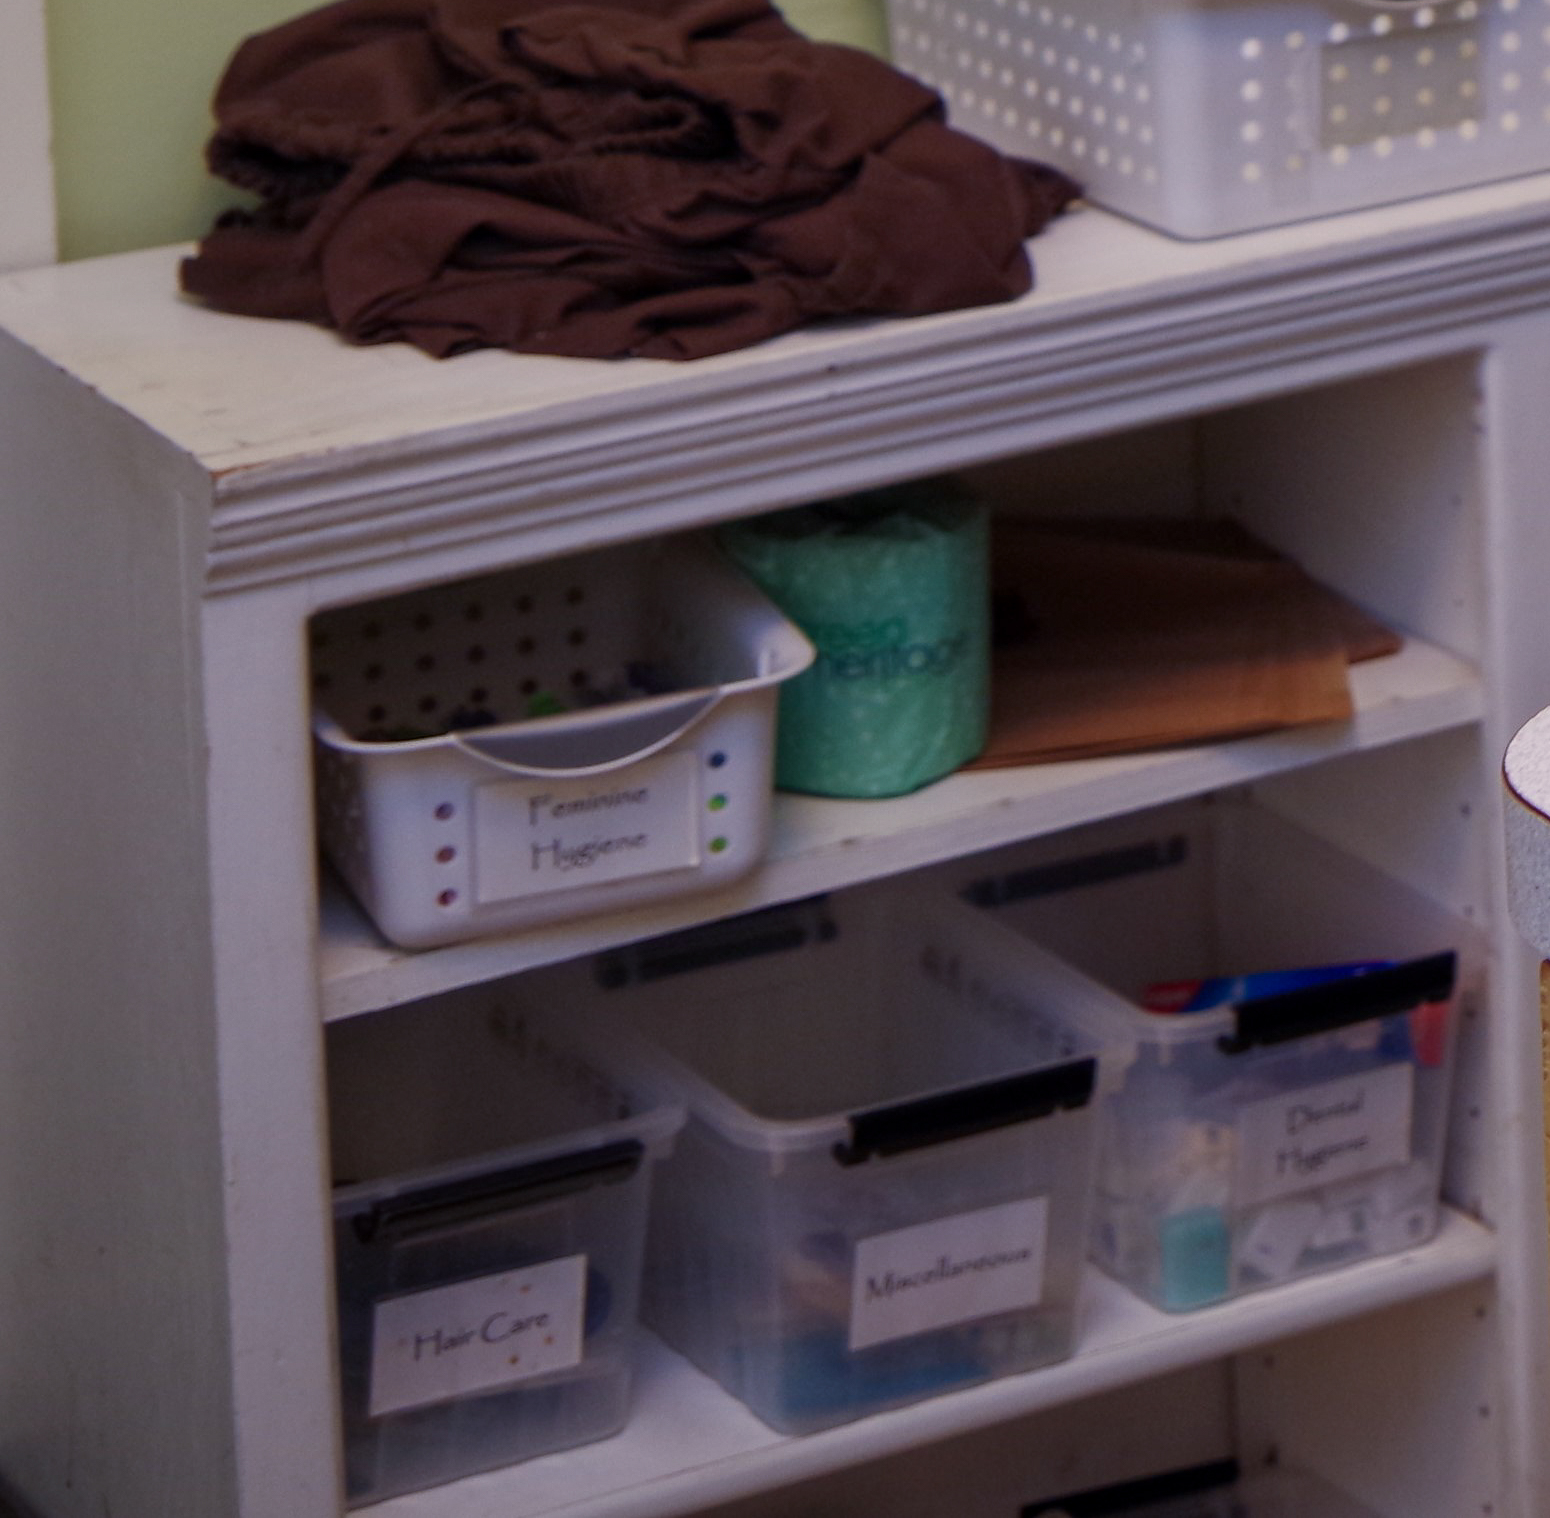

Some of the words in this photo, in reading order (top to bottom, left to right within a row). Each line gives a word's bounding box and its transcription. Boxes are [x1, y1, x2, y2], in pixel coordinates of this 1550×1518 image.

[529, 786, 650, 826] Feminine
[530, 831, 651, 872] Hygiene
[1285, 1086, 1366, 1136] Dental
[863, 1247, 1032, 1304] Miscellaneous
[413, 1327, 475, 1362] Hair
[481, 1309, 550, 1344] Care
